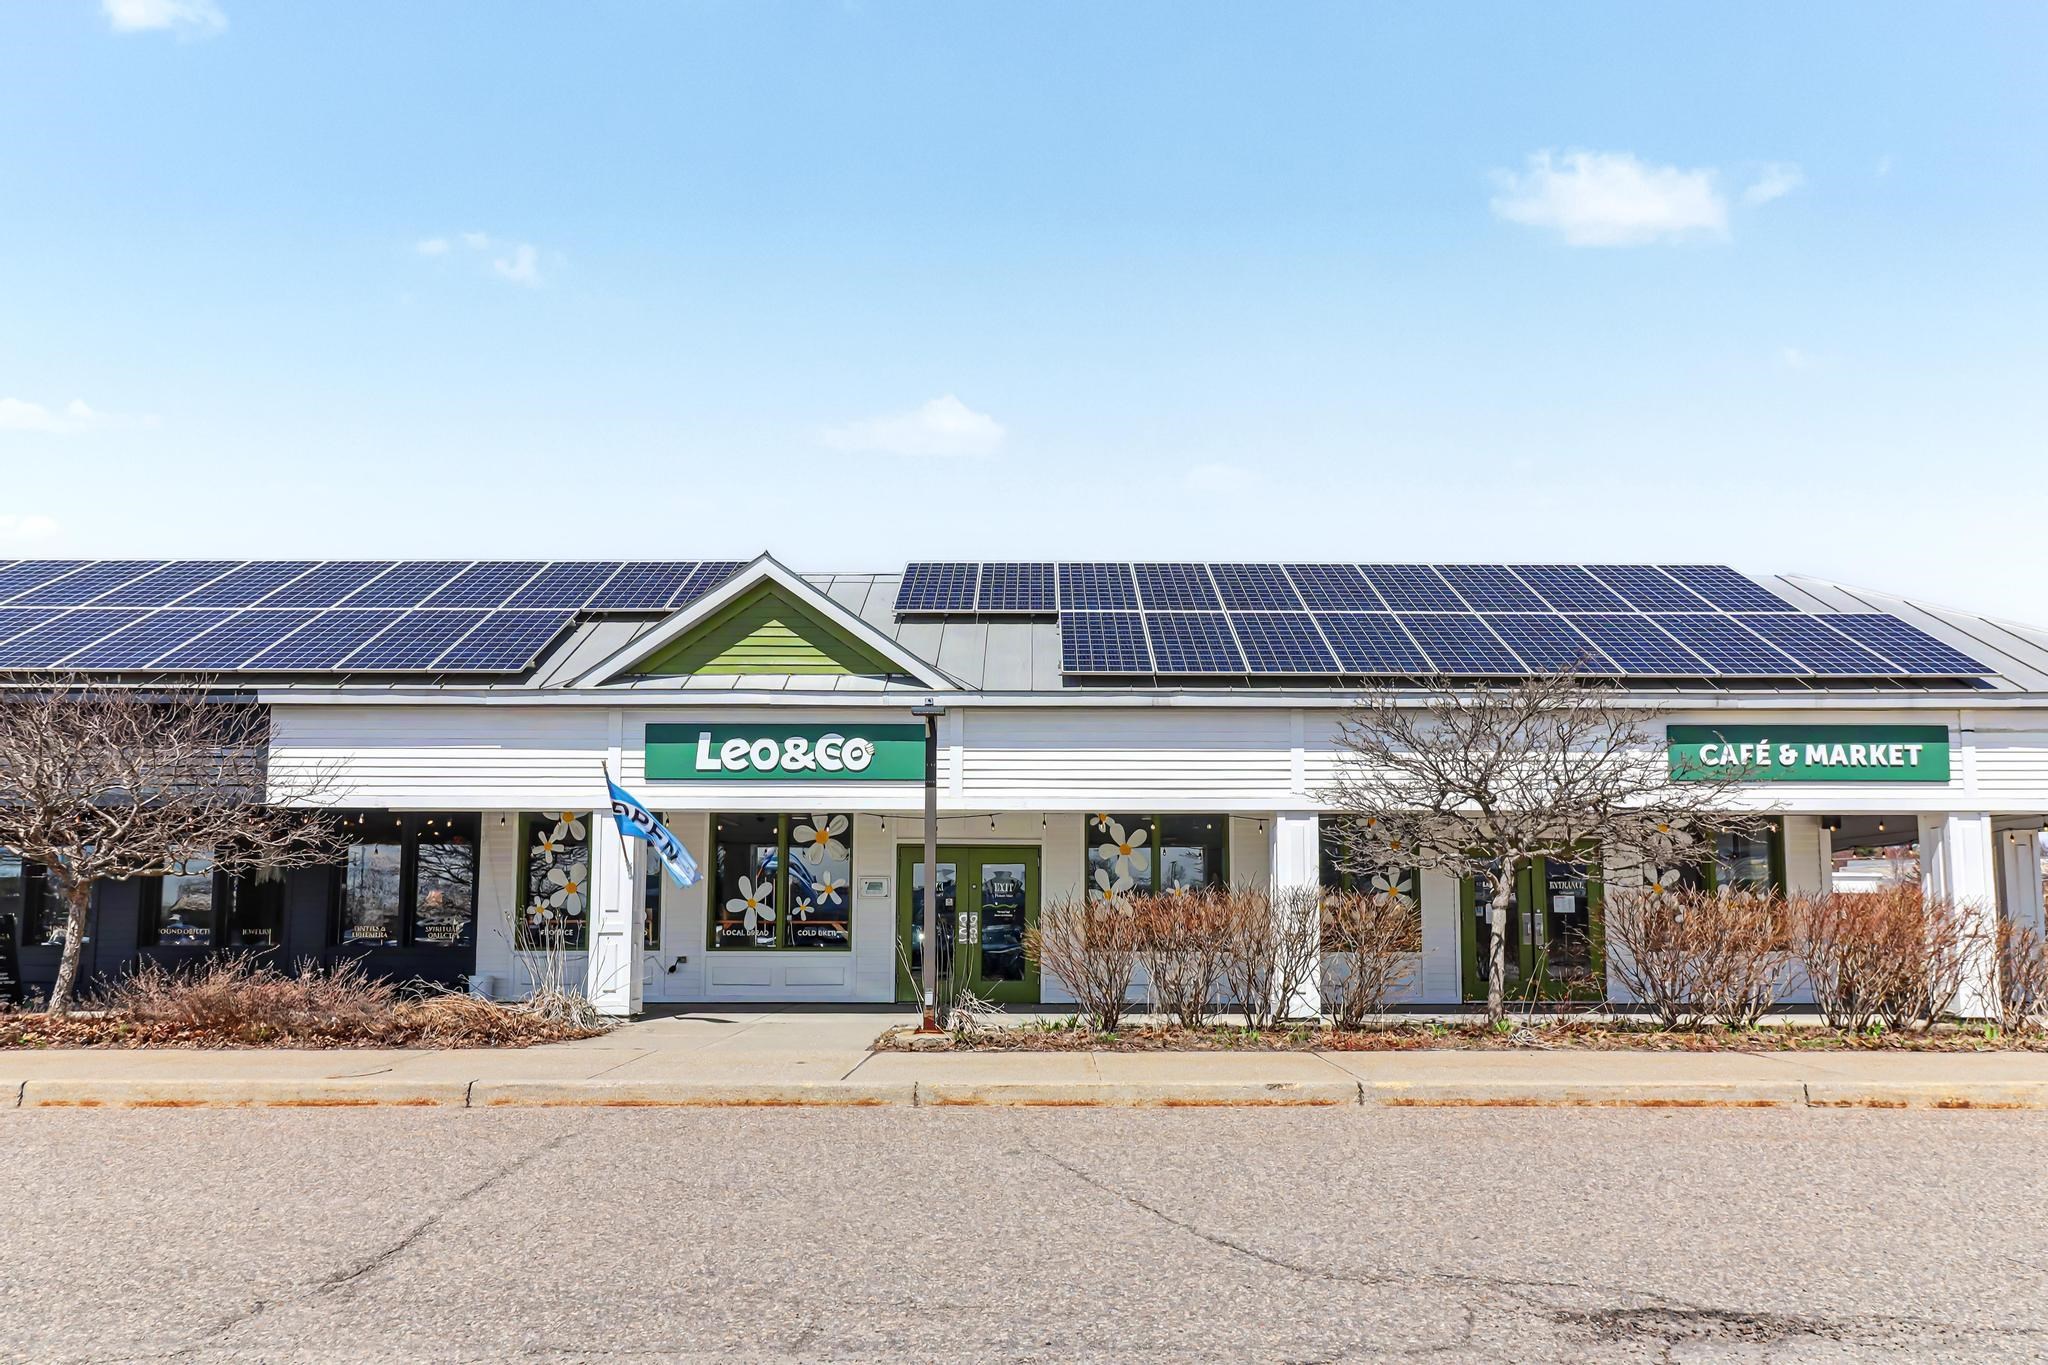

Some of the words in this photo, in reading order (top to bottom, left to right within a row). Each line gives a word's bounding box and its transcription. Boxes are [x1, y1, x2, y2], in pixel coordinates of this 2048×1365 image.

[1699, 738, 1772, 766] CAFÉ
[1778, 743, 1798, 766] &
[1805, 743, 1923, 766] MARKET
[612, 801, 680, 861] OPEN
[994, 882, 1014, 892] EXIT
[1549, 881, 1584, 890] ENTRANCE
